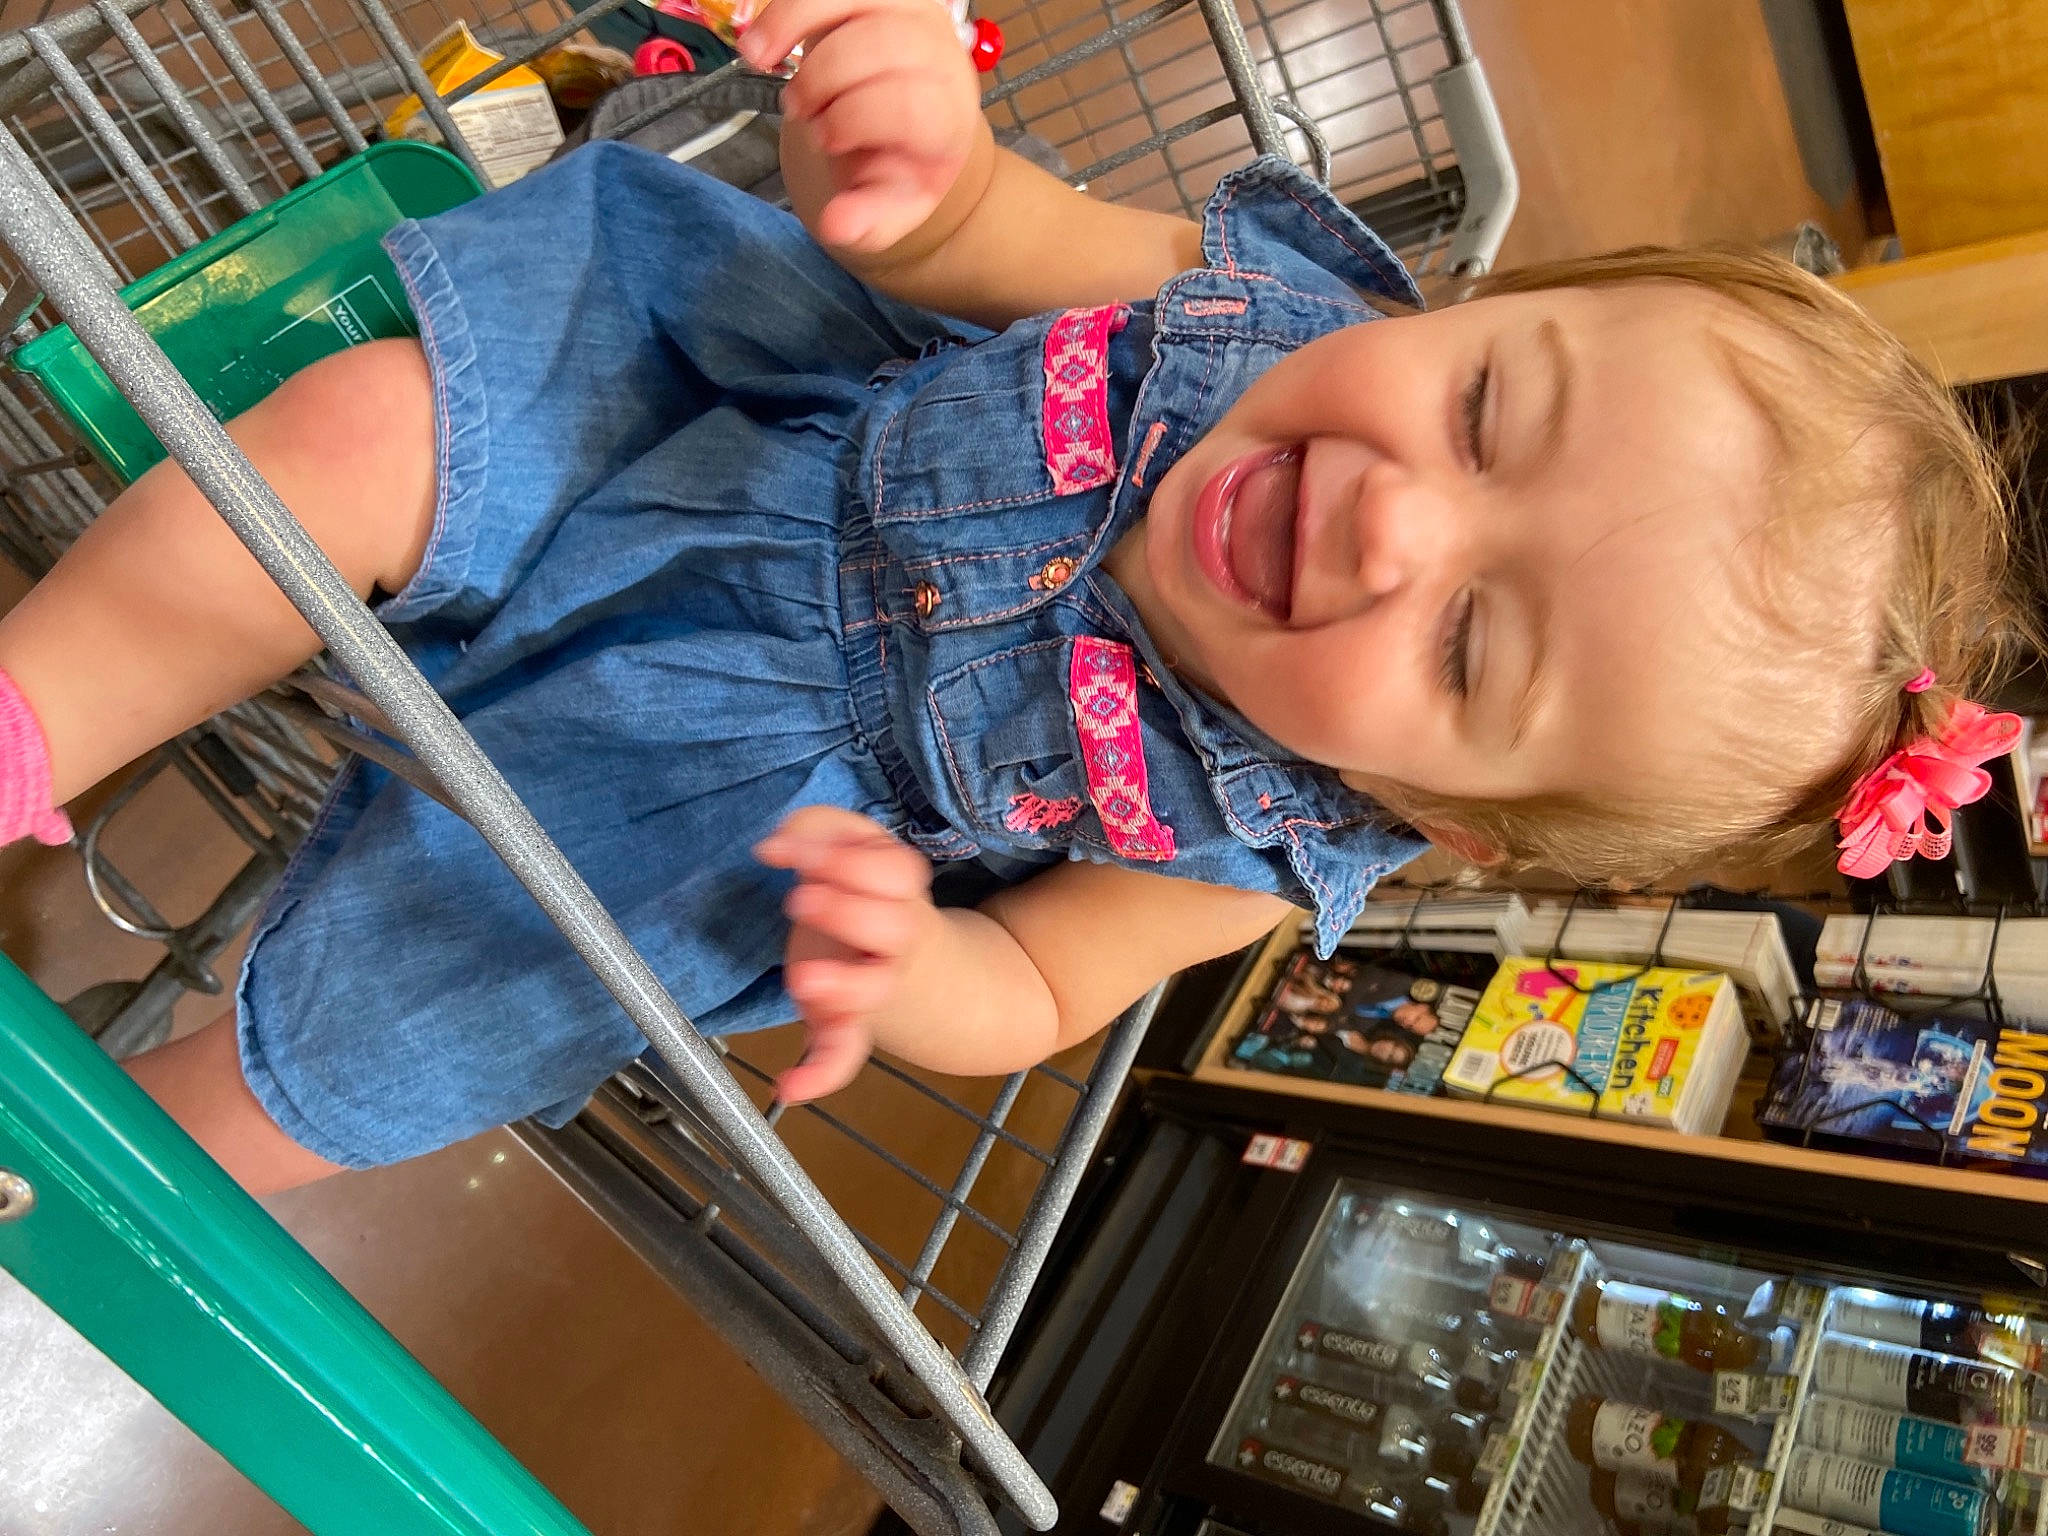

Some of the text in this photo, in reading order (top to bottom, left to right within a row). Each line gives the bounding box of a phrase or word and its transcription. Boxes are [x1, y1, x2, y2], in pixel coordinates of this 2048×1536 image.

[335, 305, 364, 341] Your
[1611, 988, 1662, 1089] Kitchen
[1967, 1029, 2048, 1156] MOON
[1323, 1330, 1398, 1368] essentia
[1300, 1387, 1377, 1424] essentia
[1264, 1450, 1341, 1493] essentia
